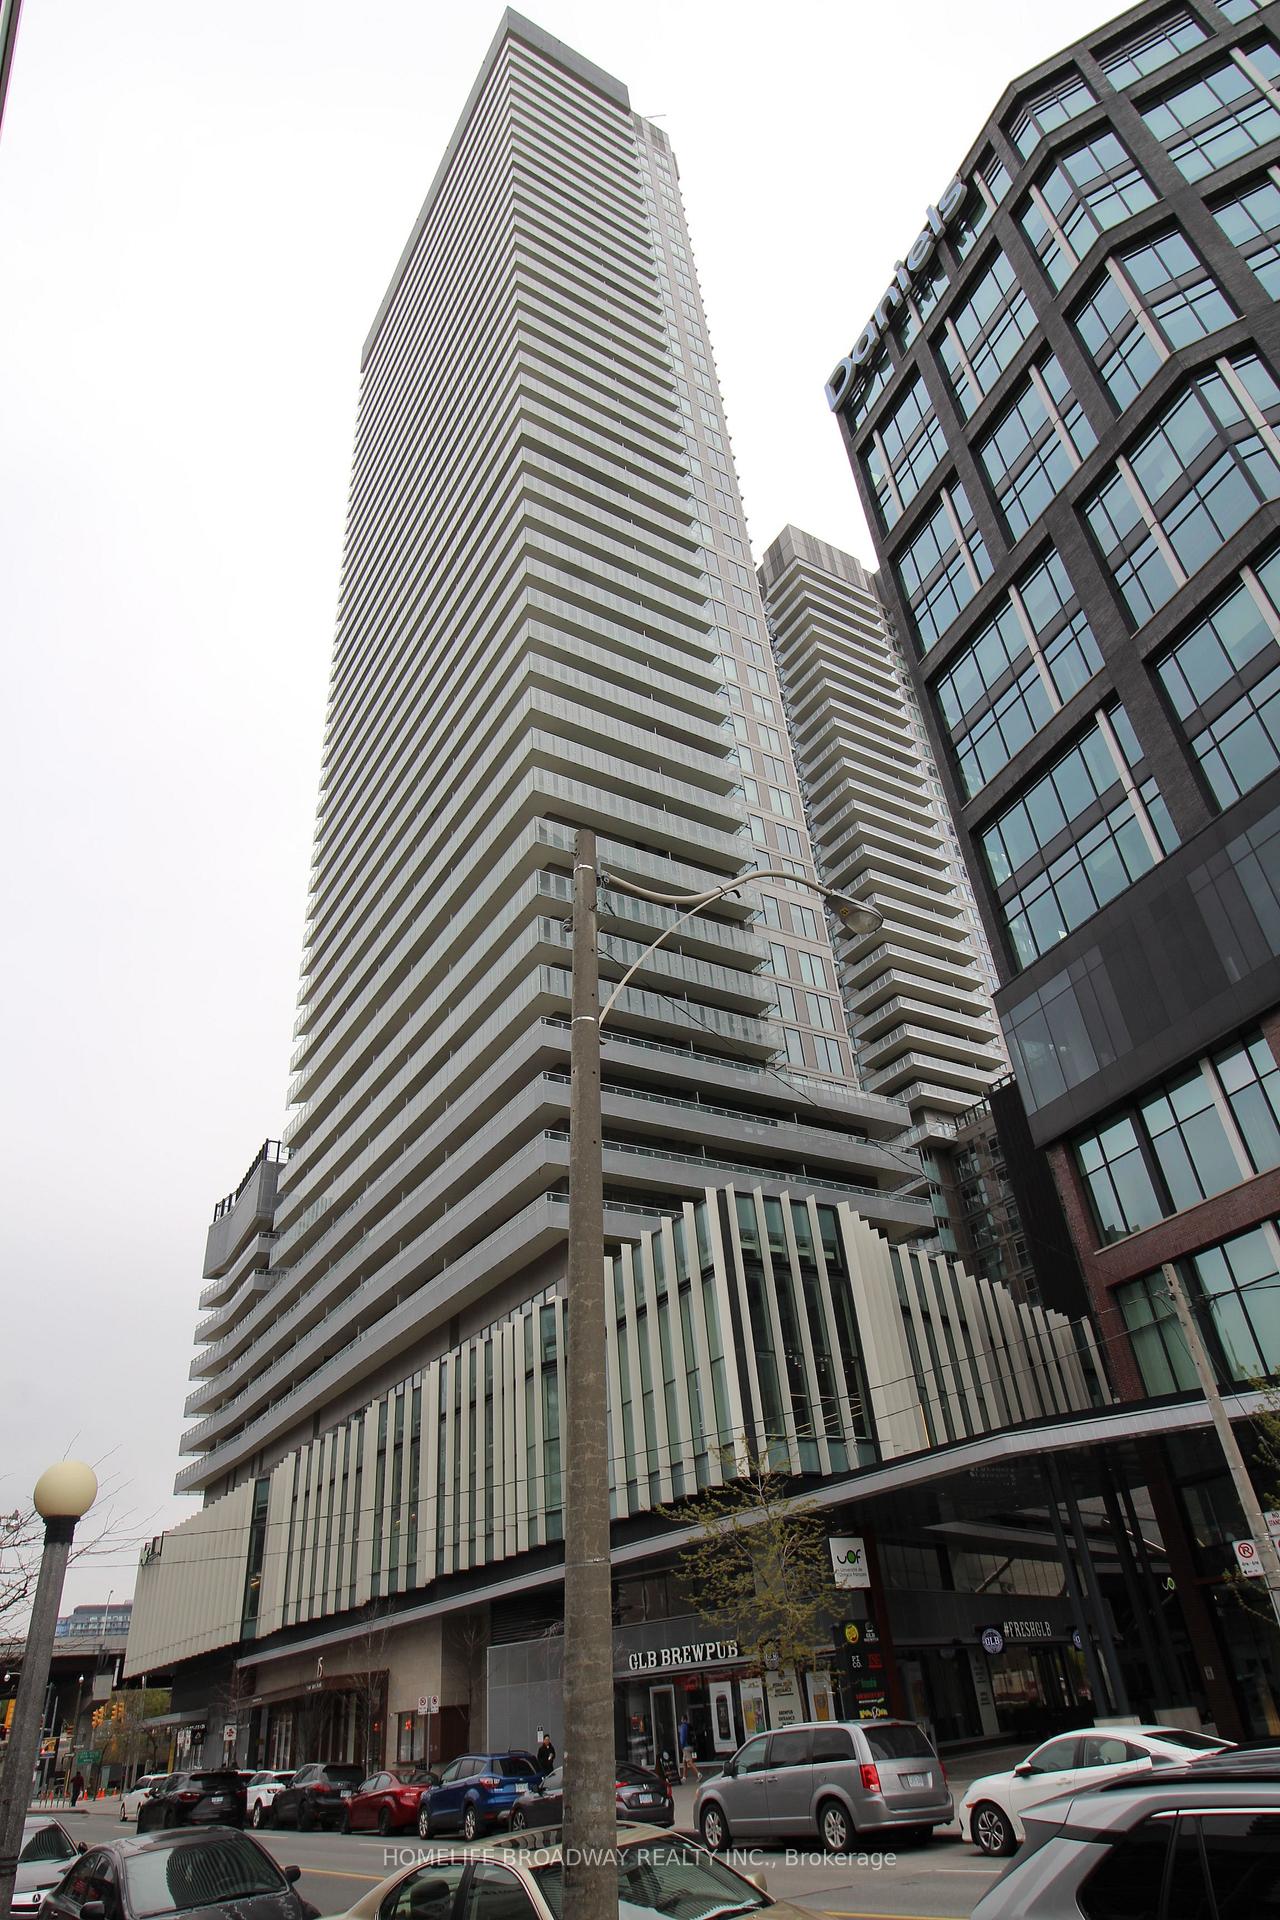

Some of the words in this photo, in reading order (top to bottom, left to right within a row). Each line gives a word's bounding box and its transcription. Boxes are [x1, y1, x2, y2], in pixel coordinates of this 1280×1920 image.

[824, 175, 967, 412] Daniels
[1003, 1621, 1052, 1638] #FRESHGLB
[628, 1651, 657, 1670] GLB
[660, 1640, 738, 1666] BREWPUB
